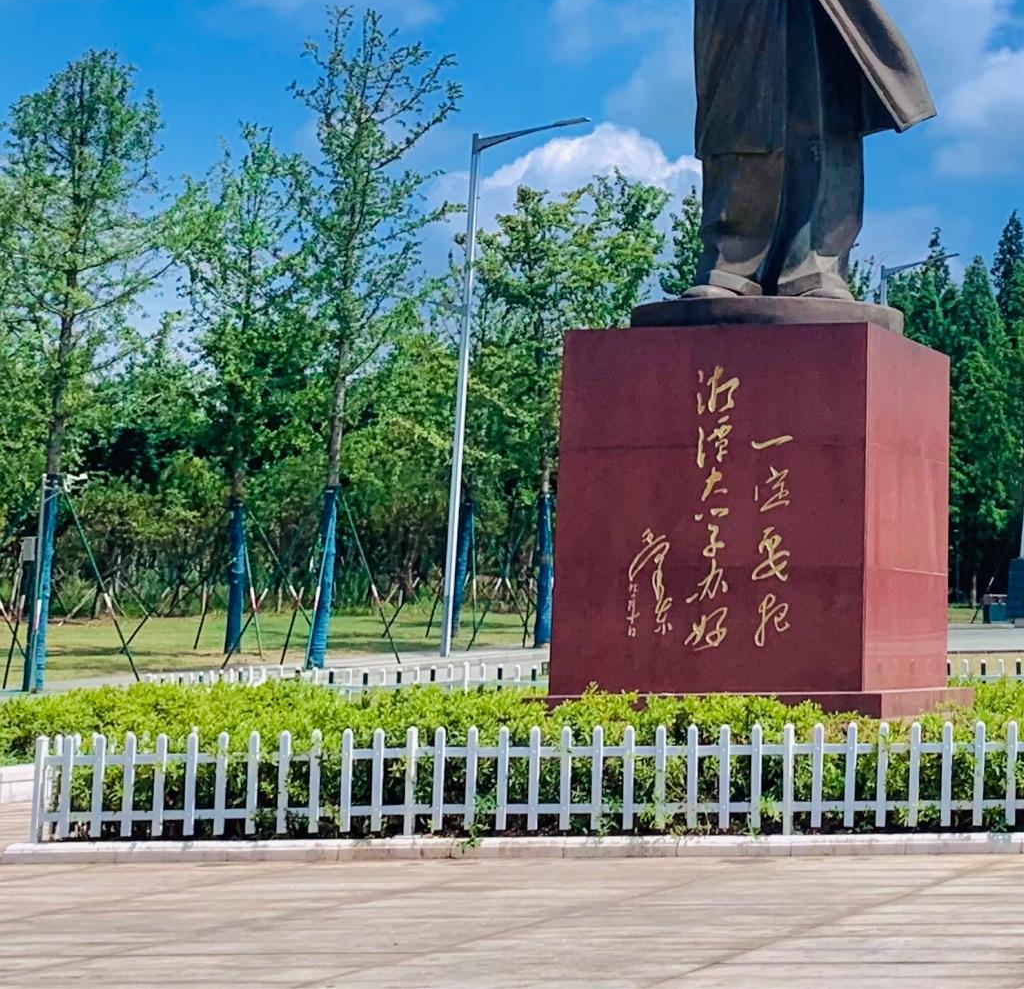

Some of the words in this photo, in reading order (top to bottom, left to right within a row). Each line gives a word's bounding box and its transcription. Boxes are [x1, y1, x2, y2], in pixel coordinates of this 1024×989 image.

[685, 366, 740, 650] 湘潭大学办好
[751, 435, 794, 647] 一定要把
